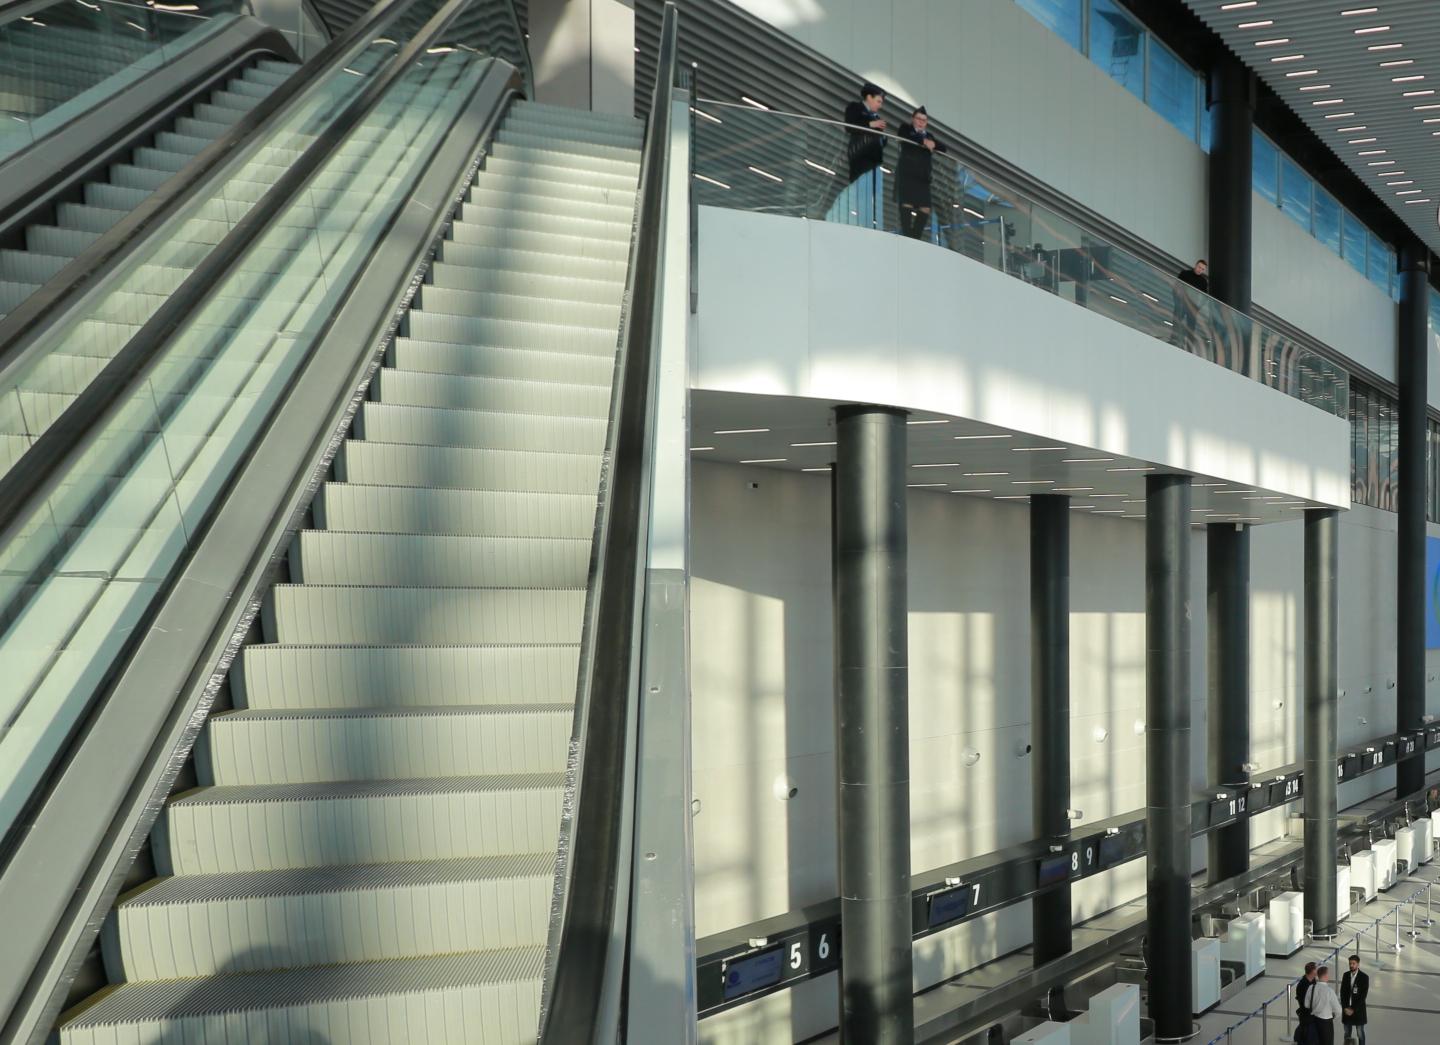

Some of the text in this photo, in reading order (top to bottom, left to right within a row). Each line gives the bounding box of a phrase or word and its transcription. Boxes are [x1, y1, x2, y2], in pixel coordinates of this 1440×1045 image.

[1292, 779, 1298, 793] 14
[1229, 797, 1245, 815] 11 12
[1072, 847, 1093, 871] 8 9
[972, 884, 980, 906] 7
[790, 933, 829, 969] 5 6
